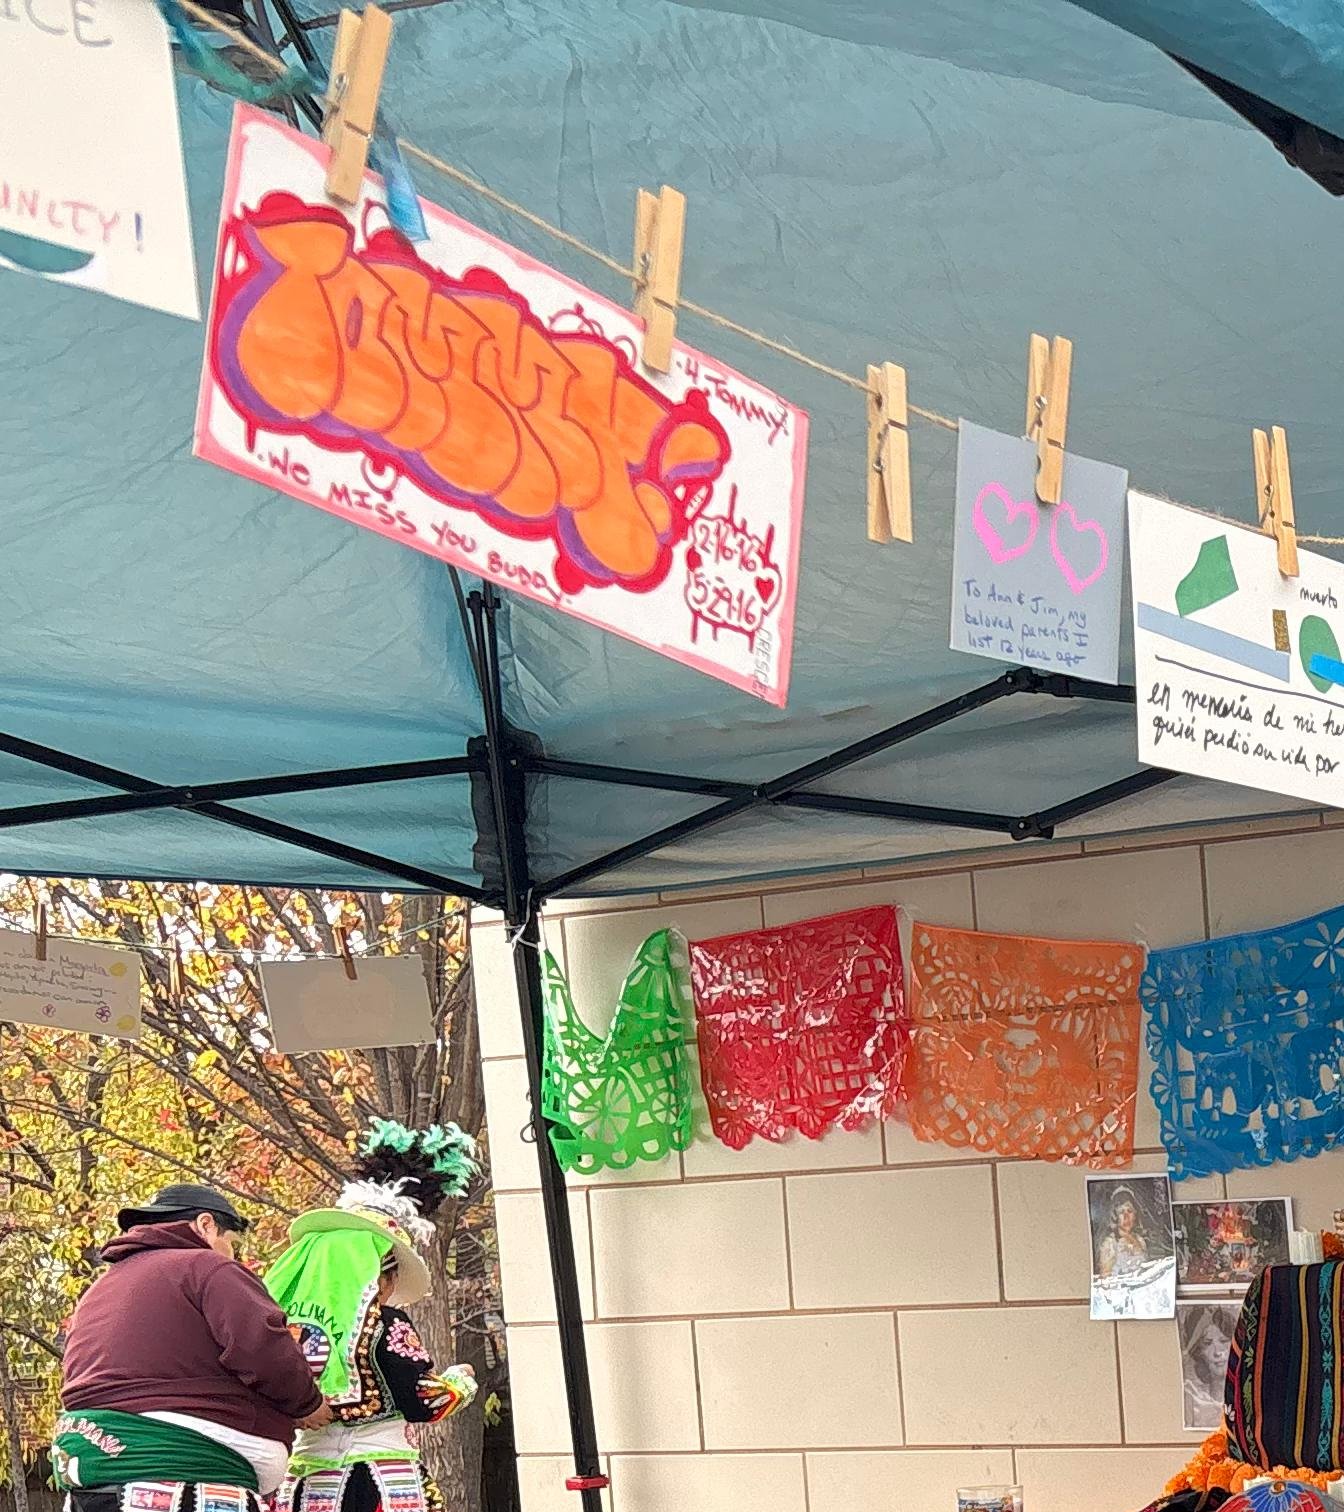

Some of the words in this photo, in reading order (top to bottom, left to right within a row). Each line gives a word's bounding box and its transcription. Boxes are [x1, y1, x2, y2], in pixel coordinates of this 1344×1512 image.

[328, 481, 417, 535] MISS
[430, 520, 477, 554] YOU
[963, 579, 981, 598] To
[963, 605, 1015, 632] beloved
